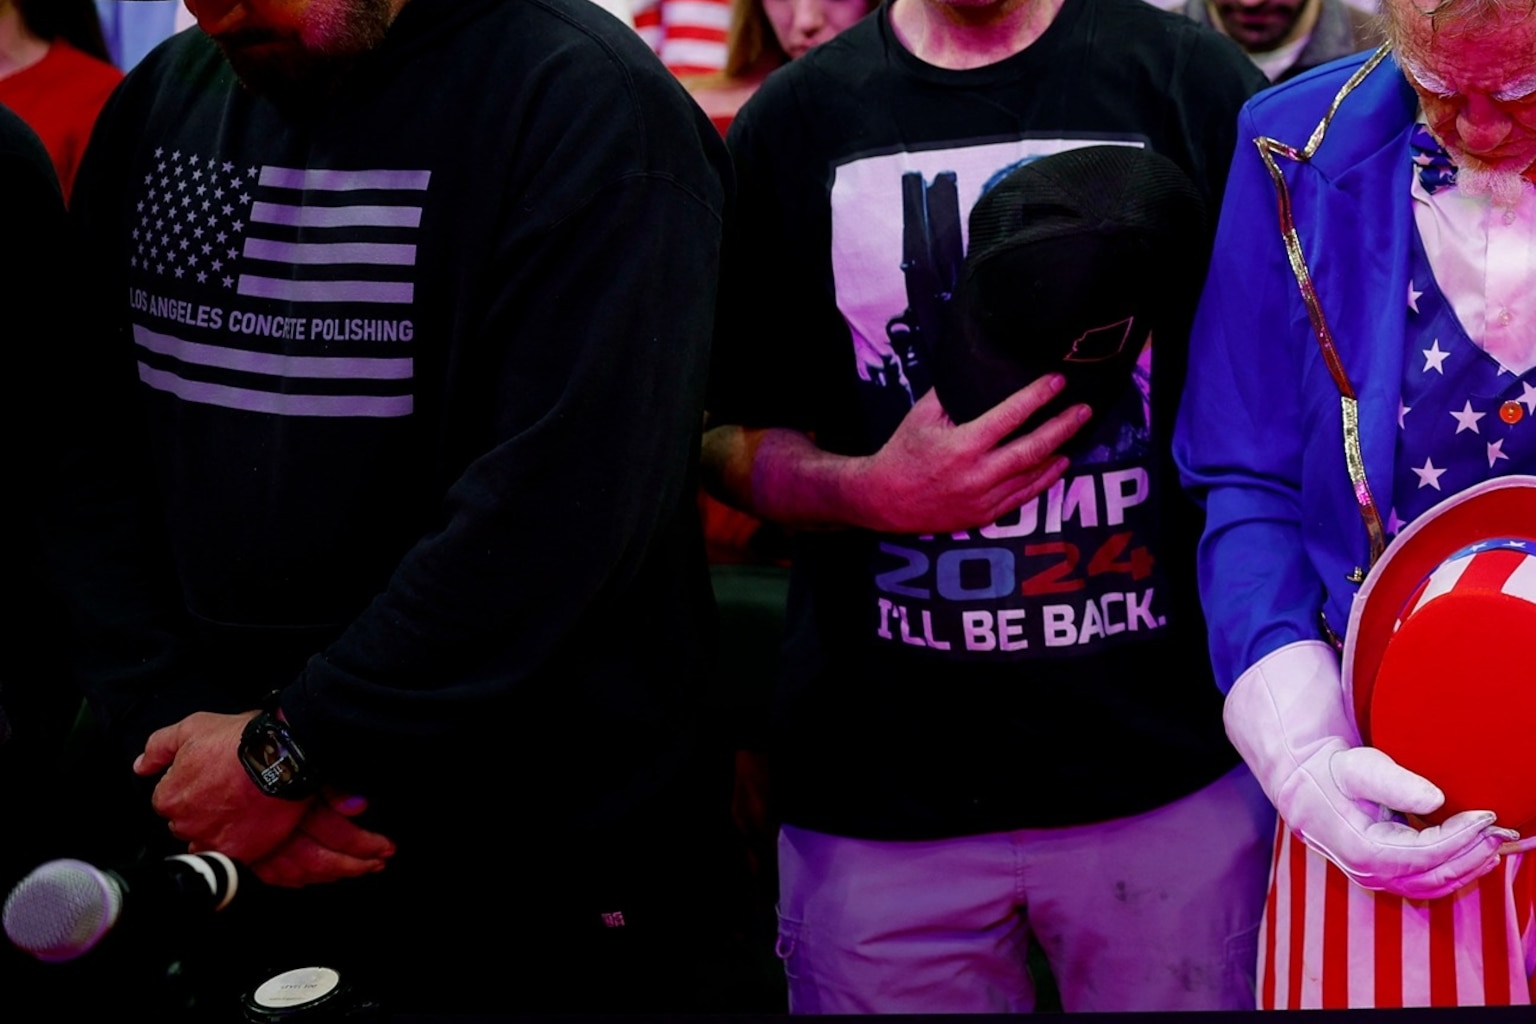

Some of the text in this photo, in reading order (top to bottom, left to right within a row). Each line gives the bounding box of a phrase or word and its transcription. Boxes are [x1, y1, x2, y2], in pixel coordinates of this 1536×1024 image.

[129, 287, 148, 313] LOS
[149, 295, 223, 330] ANGELES
[310, 318, 414, 342] POLISHING
[918, 466, 1149, 541] UMP
[875, 530, 1156, 601] 2024
[877, 588, 1167, 652] I'LL BE BACK.
